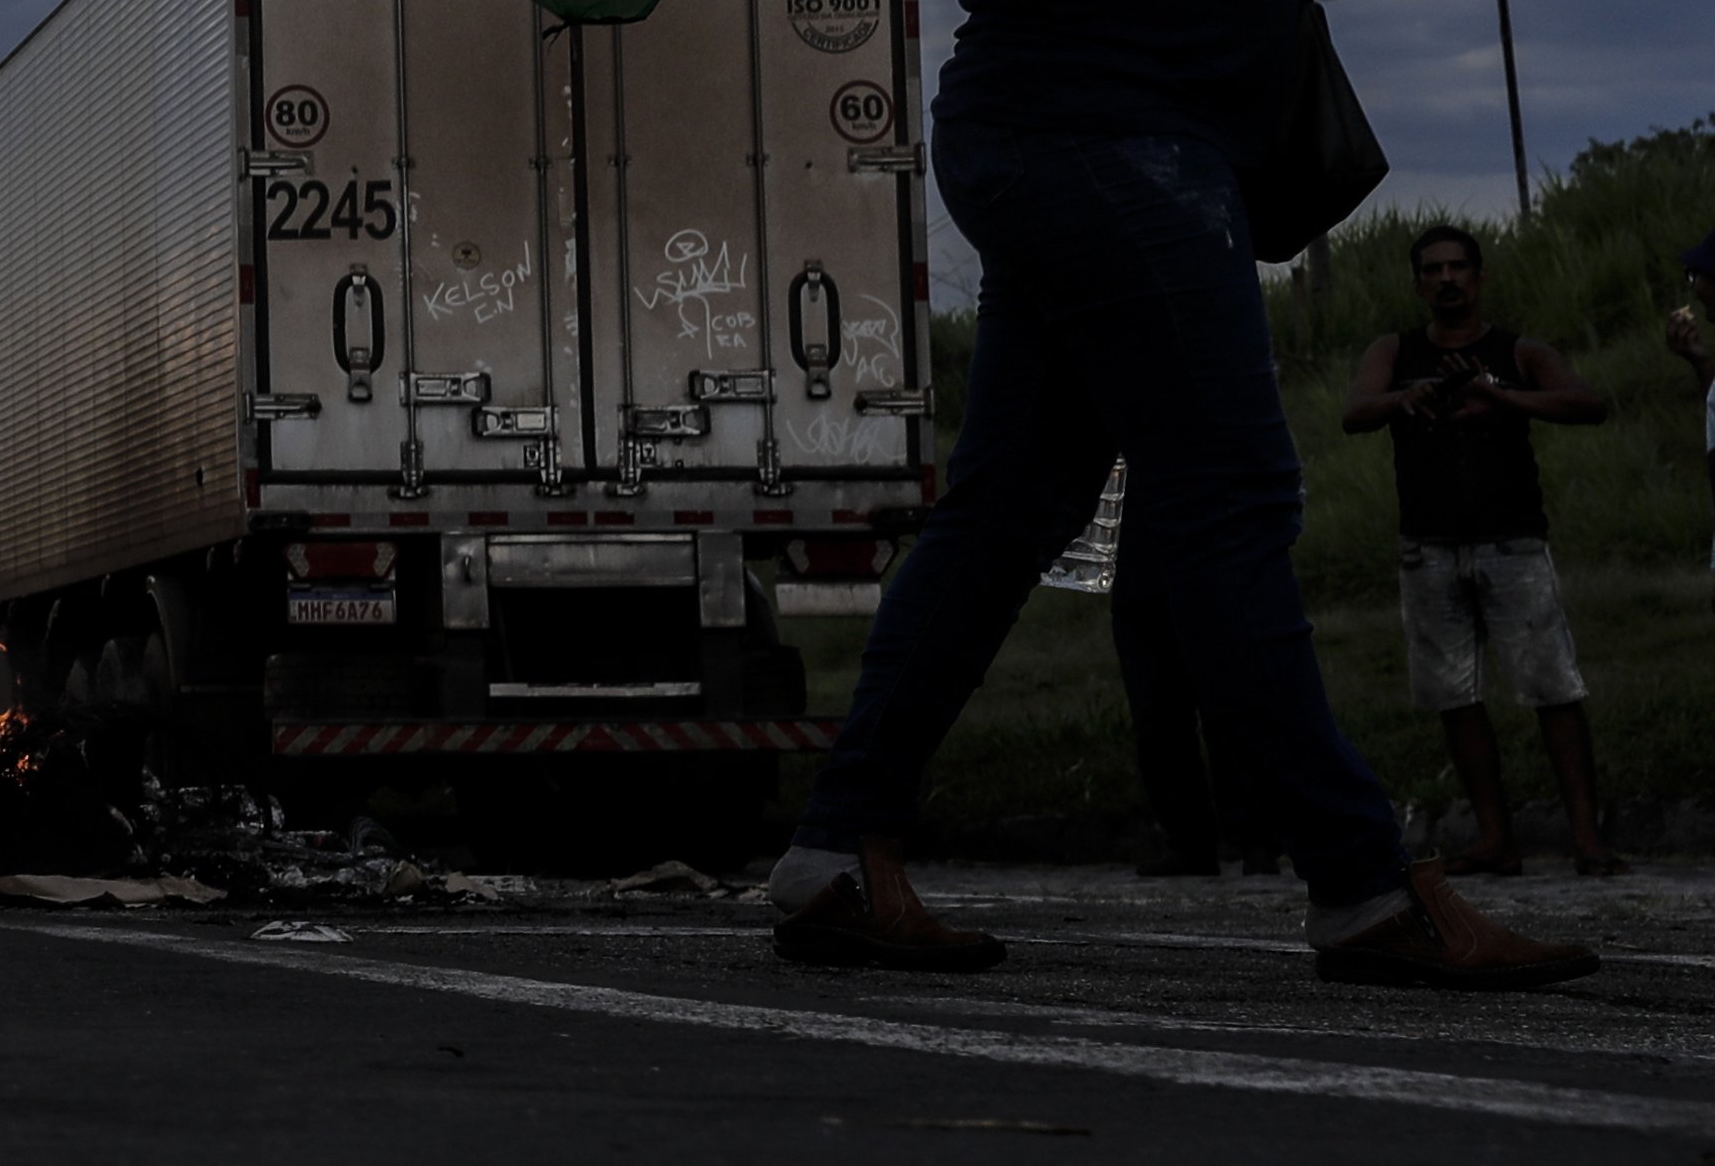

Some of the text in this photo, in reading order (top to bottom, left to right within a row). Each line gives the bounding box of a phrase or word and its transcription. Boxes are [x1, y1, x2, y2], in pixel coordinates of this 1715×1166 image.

[275, 100, 319, 127] 80
[840, 94, 884, 121] 60
[267, 180, 397, 240] 2245
[423, 239, 532, 322] KELSON
